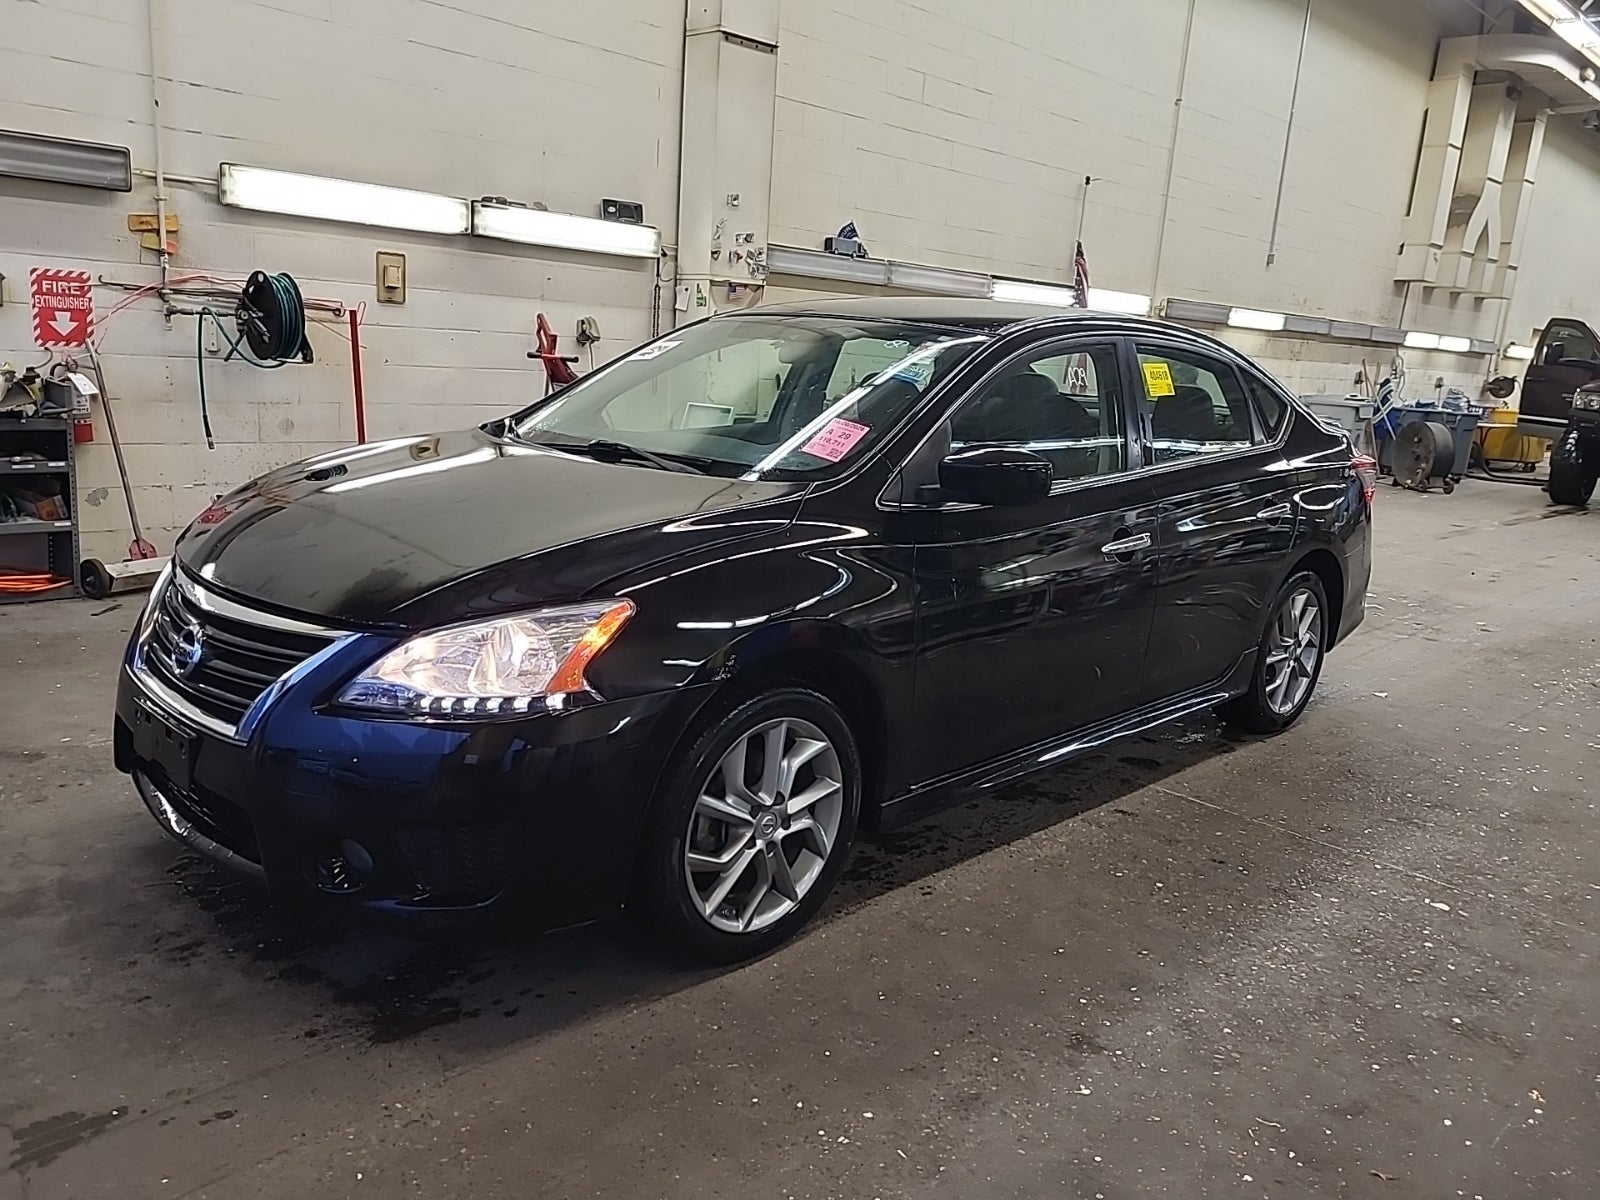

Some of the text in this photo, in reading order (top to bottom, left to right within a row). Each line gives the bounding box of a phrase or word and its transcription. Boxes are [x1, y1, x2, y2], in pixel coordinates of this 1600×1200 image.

[42, 280, 81, 295] FIRE
[35, 295, 89, 310] EXTINGUISHER
[826, 428, 834, 436] A
[838, 431, 852, 441] 29
